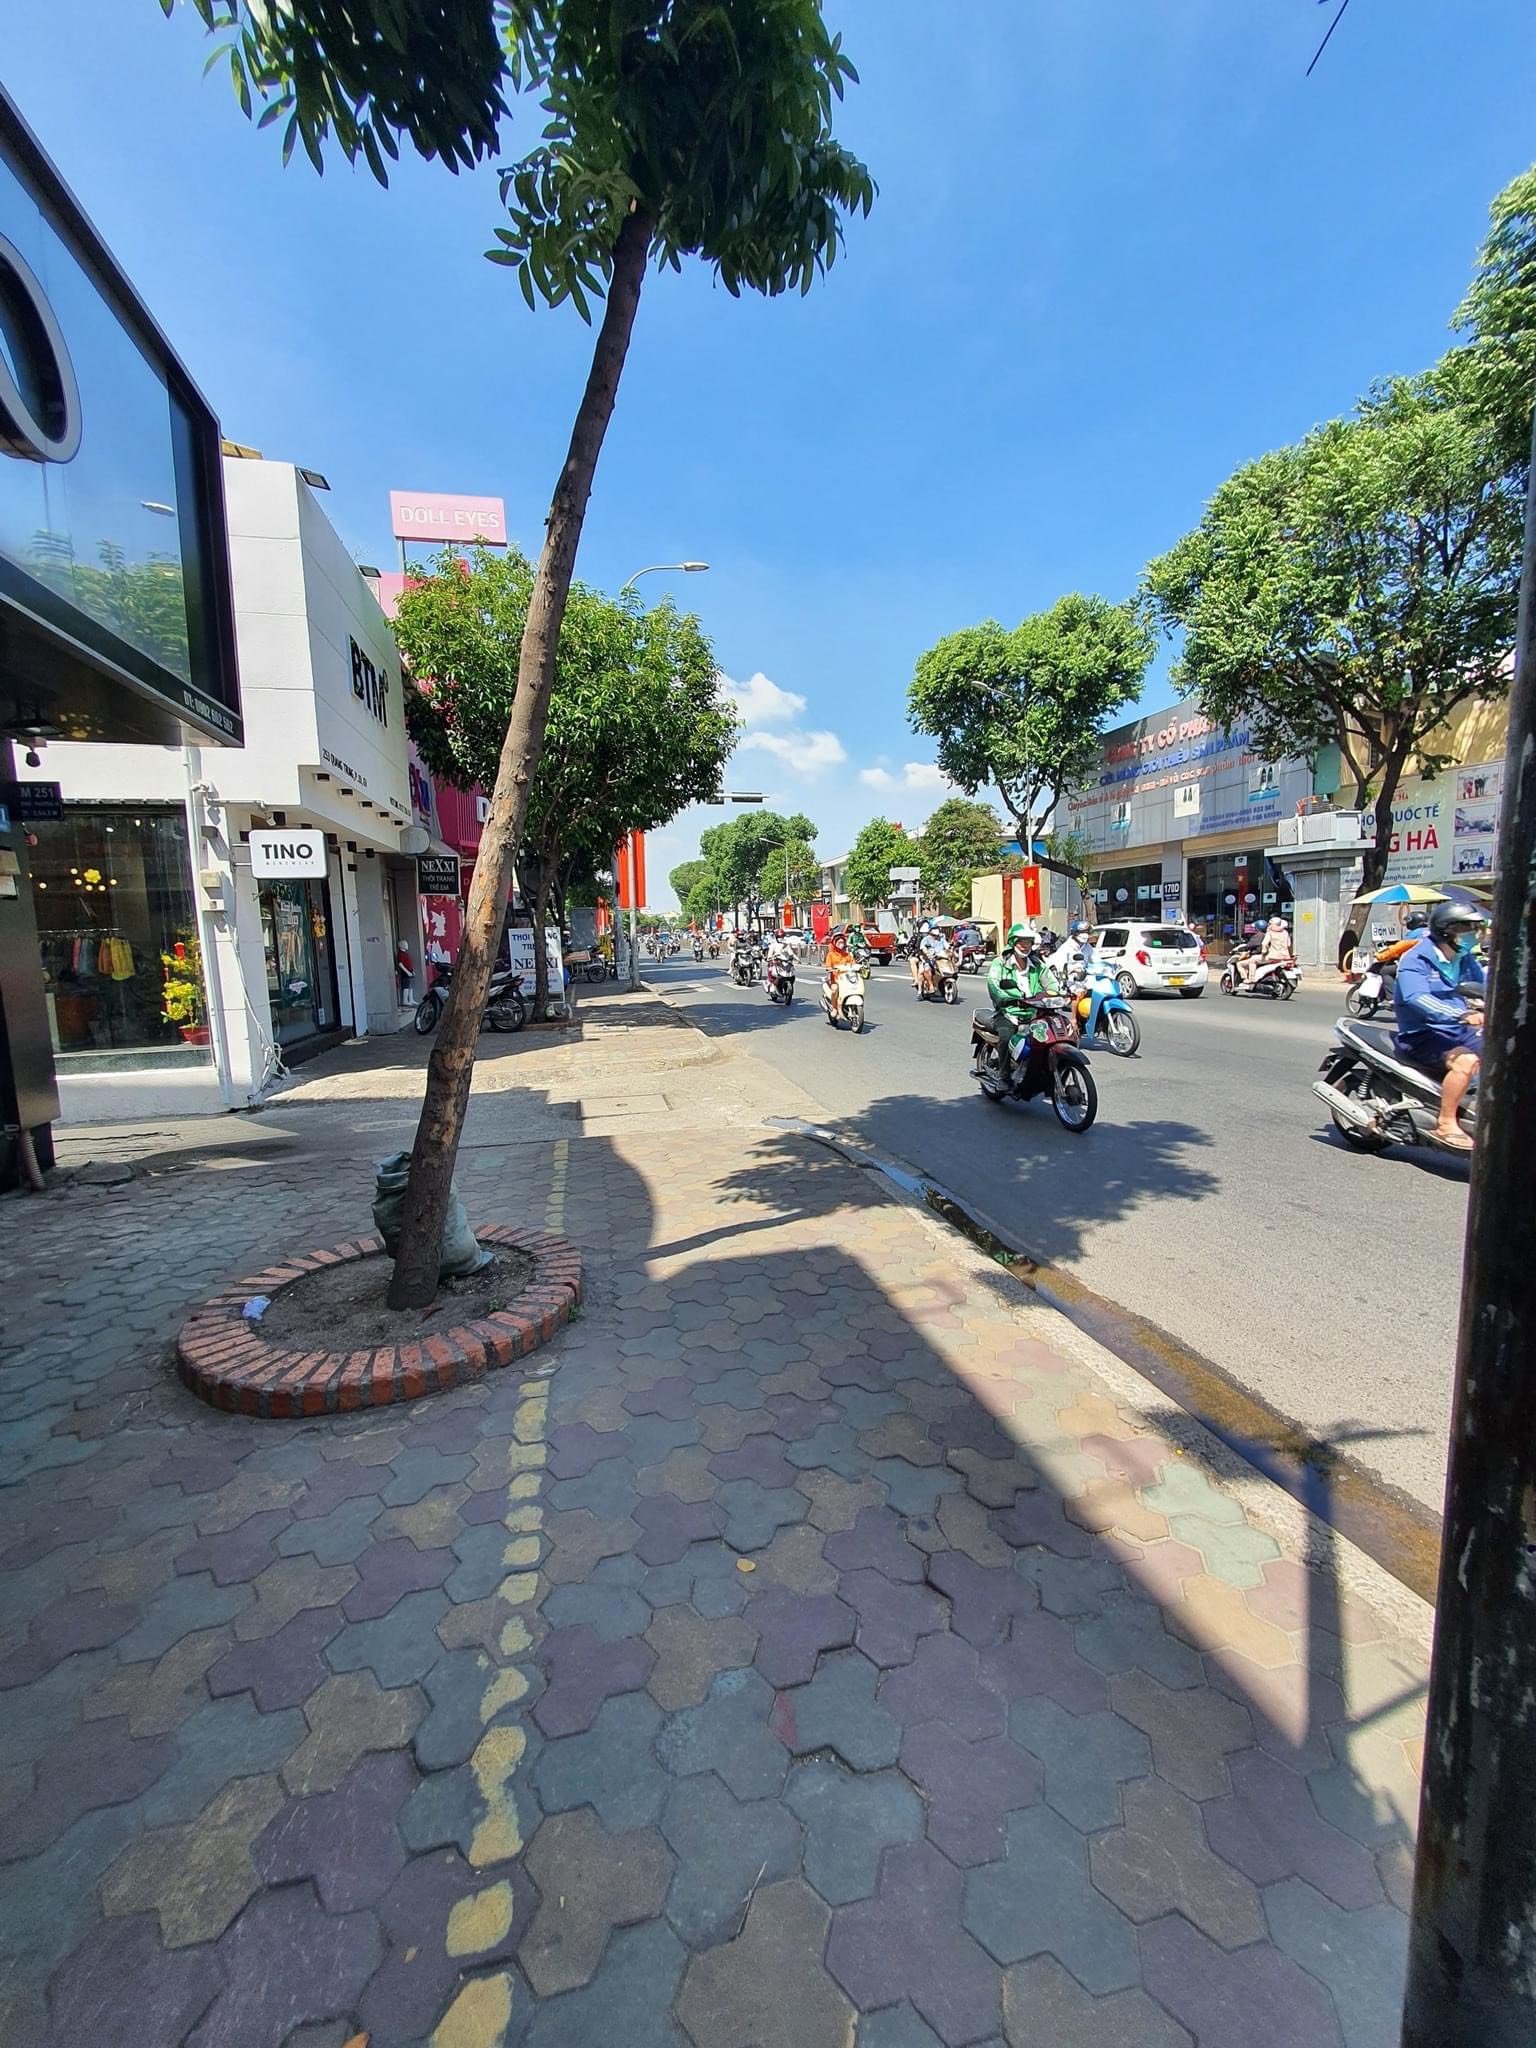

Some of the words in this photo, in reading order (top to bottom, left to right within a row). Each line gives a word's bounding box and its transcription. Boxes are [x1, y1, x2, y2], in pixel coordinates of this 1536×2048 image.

[401, 506, 449, 525] DOLL
[454, 510, 500, 528] EYES
[1157, 716, 1177, 749] CỔ
[1406, 824, 1439, 852] HÀ
[261, 844, 313, 859] TINO
